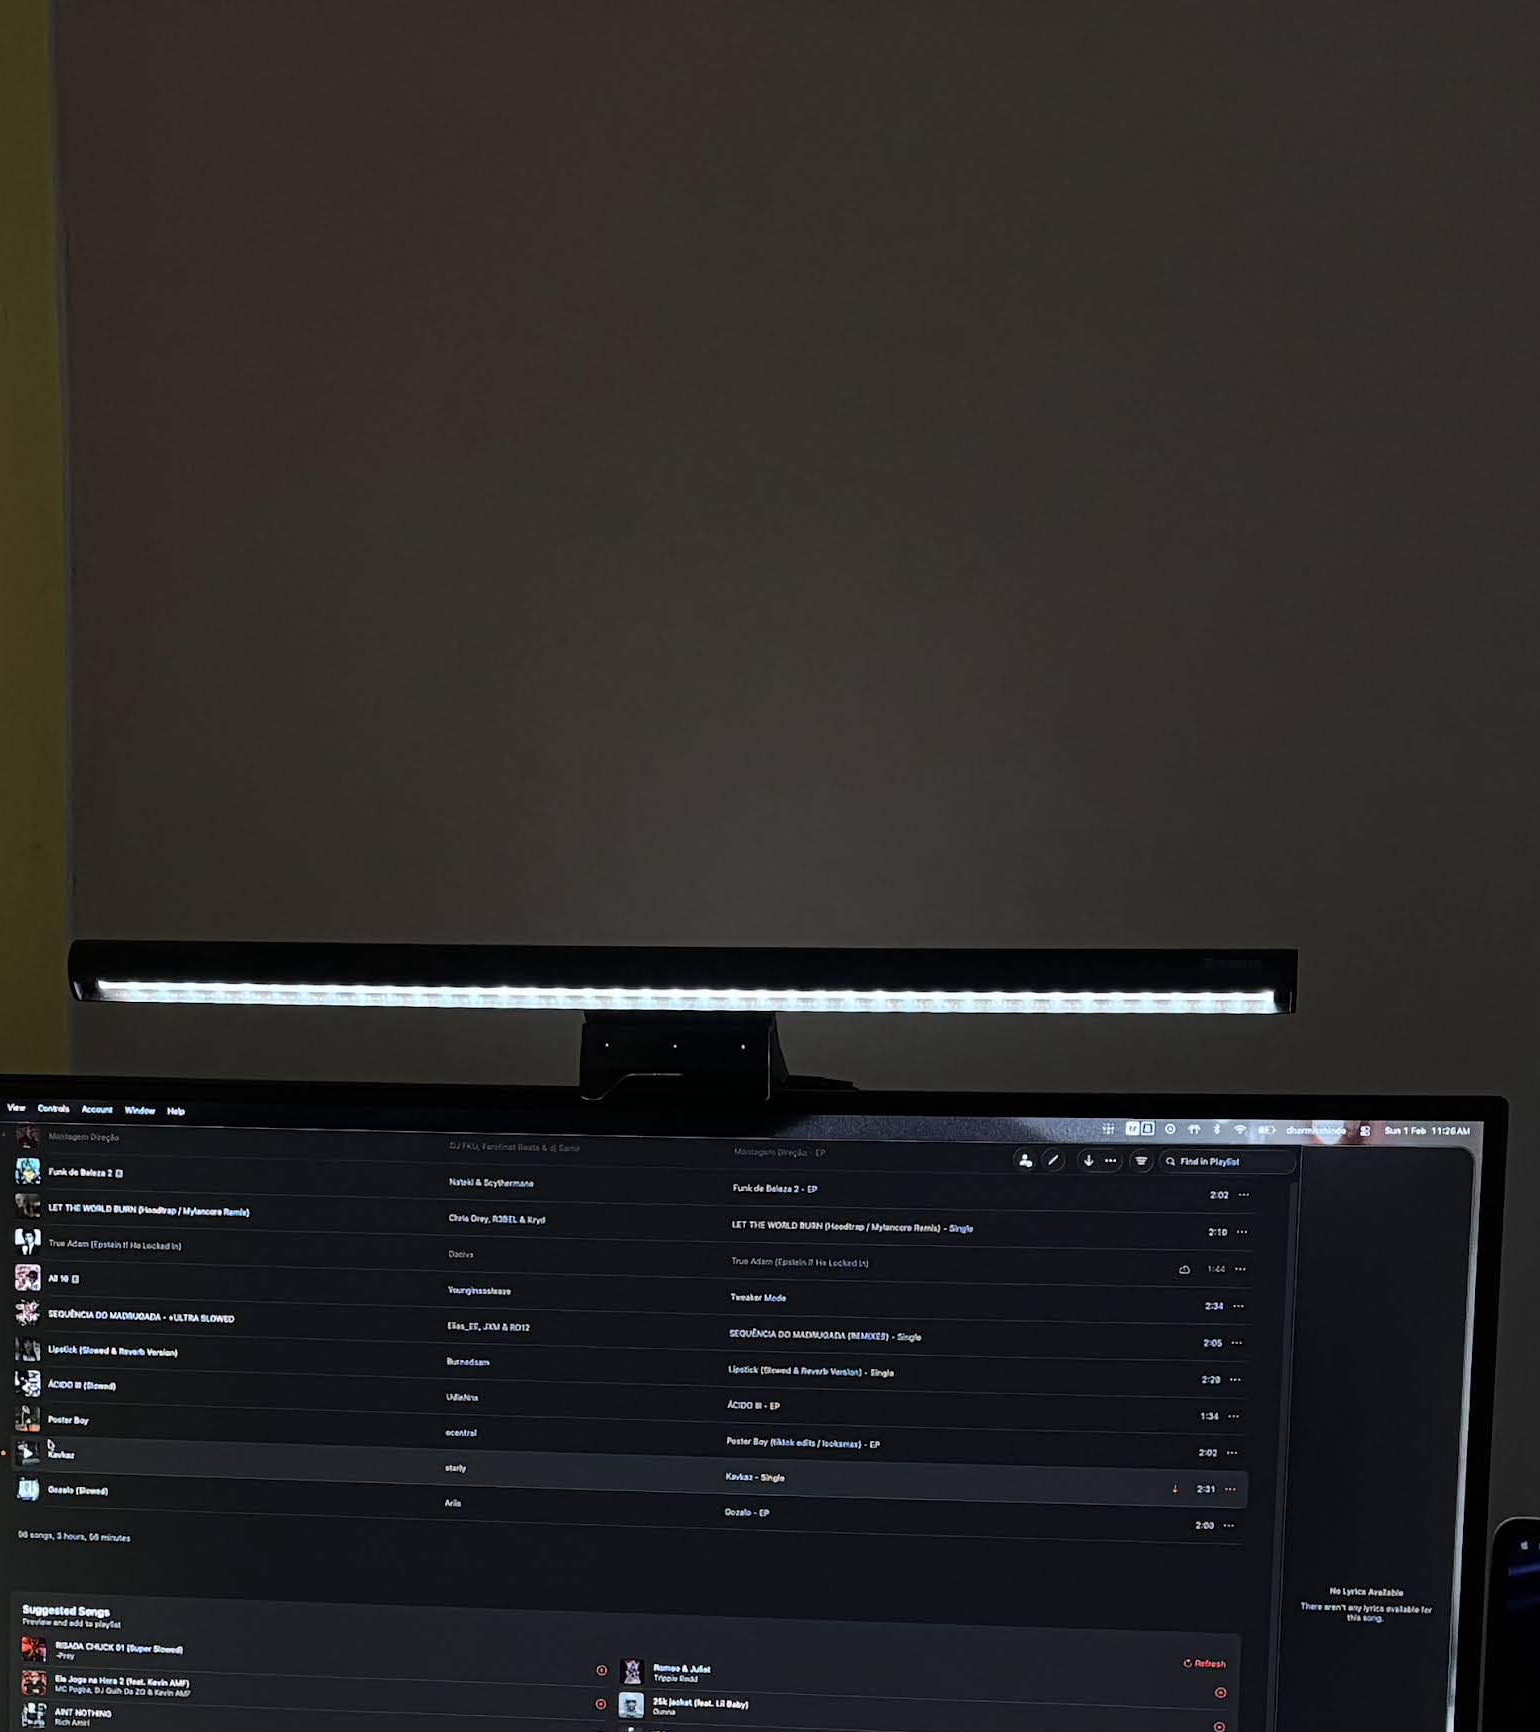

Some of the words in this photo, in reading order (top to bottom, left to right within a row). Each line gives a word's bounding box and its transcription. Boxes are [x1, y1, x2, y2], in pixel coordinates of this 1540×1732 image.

[7, 1103, 26, 1111] View
[38, 1104, 70, 1112] Controls
[82, 1105, 113, 1113] Account
[125, 1106, 155, 1115] Window
[167, 1107, 185, 1116] Help
[1200, 1157, 1208, 1165] in
[1210, 1158, 1239, 1167] Playlist
[65, 1204, 81, 1212] THE
[83, 1205, 112, 1213] WORLD
[113, 1205, 136, 1213] BURN
[48, 1345, 77, 1354] Lipstick
[79, 1346, 109, 1355] (Slowed
[111, 1347, 117, 1355] &
[147, 1348, 178, 1358] Version)
[48, 1416, 72, 1424] Poster
[74, 1416, 89, 1425] Boy
[1343, 1588, 1366, 1596] Lyrics
[23, 1605, 76, 1616] Suggested
[78, 1606, 110, 1618] Songs
[1301, 1602, 1322, 1610] There
[1348, 1605, 1362, 1613] any
[1363, 1605, 1384, 1613] lyrics
[1363, 1615, 1384, 1623] song.
[95, 1620, 121, 1629] playlist
[1195, 1660, 1226, 1668] Refresh
